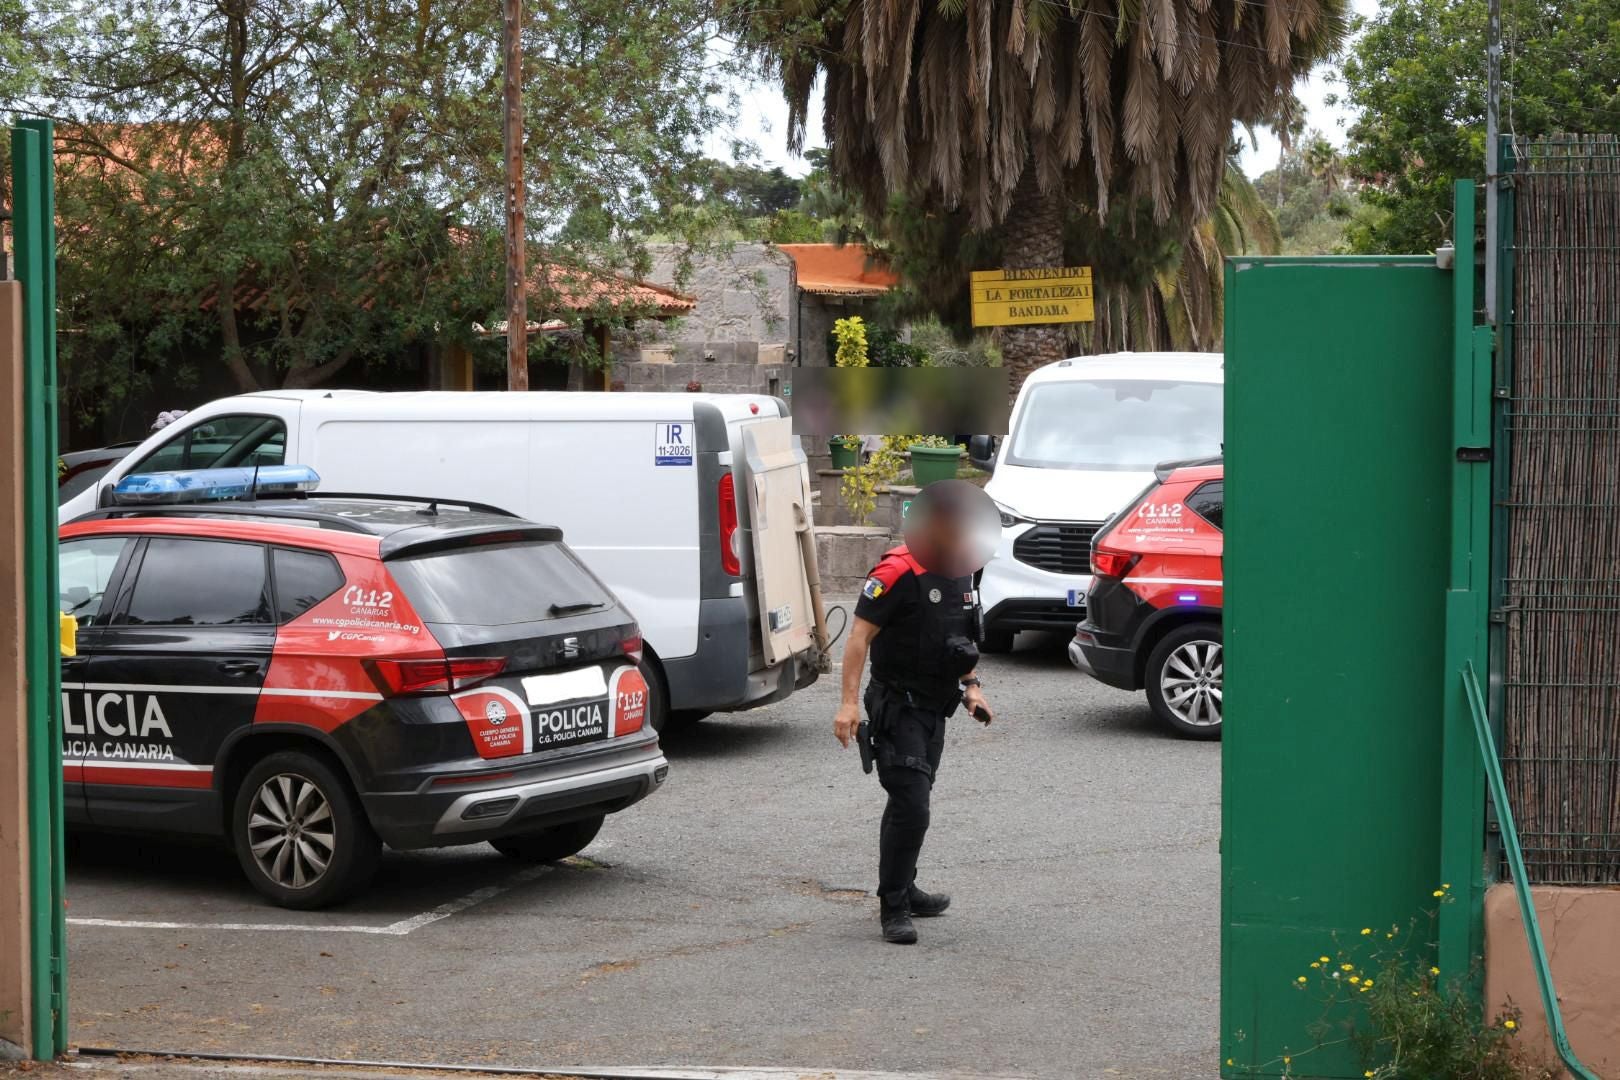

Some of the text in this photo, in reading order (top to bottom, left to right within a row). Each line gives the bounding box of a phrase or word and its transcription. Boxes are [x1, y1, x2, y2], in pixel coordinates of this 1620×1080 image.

[986, 290, 1002, 301] LA
[1009, 286, 1083, 299] FORTALEZA
[1009, 305, 1069, 318] BANDAMA
[666, 424, 682, 444] IR
[658, 445, 690, 455] 11-2026
[350, 606, 390, 617] CANARIAS
[312, 617, 420, 634] www.cgpoliciacanaria.org
[538, 704, 602, 734] POLICIA
[538, 726, 603, 744] C.G. POLICIA CANARIA
[102, 741, 174, 760] CANARIA
